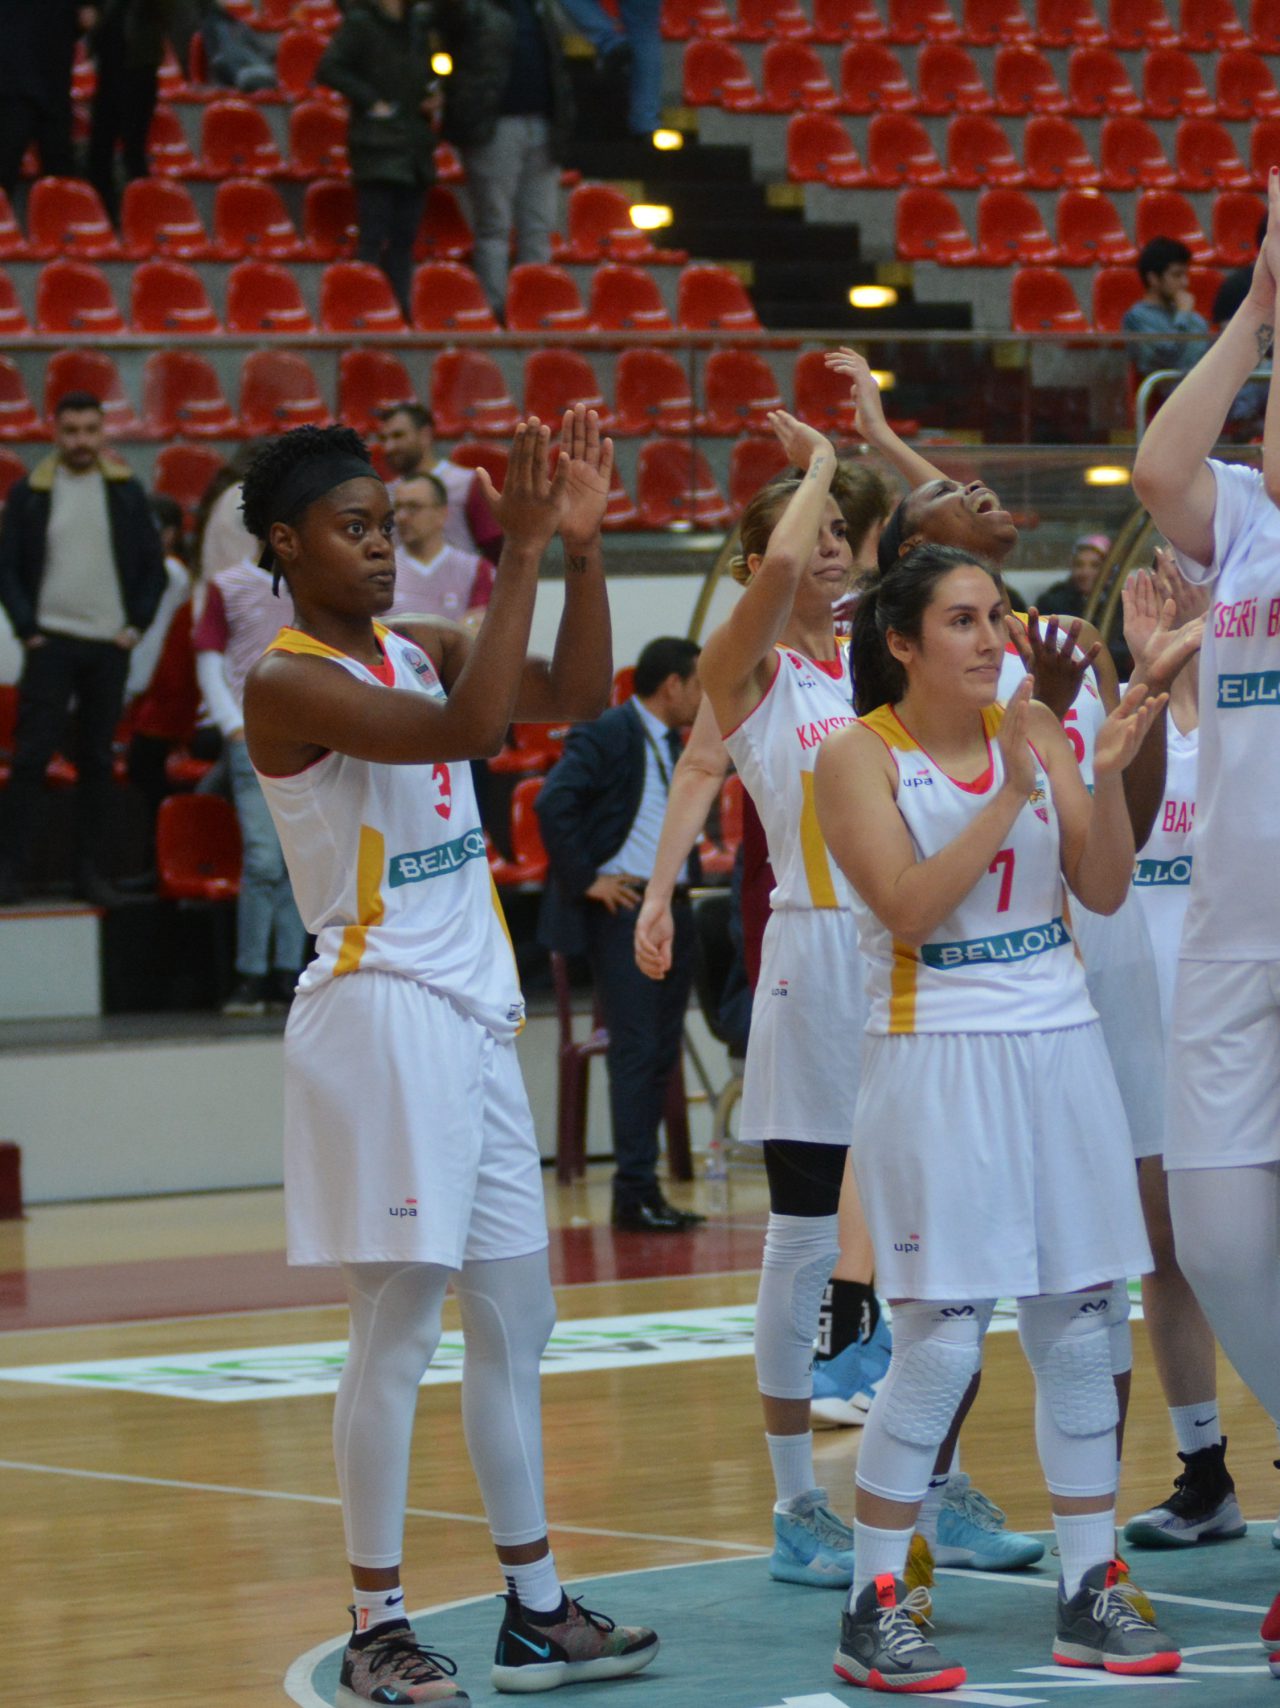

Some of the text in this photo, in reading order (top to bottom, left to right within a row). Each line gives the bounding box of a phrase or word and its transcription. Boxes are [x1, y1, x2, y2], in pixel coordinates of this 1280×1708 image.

[432, 761, 452, 822] 3
[903, 776, 934, 789] upa
[987, 847, 1016, 913] 7
[389, 1207, 418, 1219] upa
